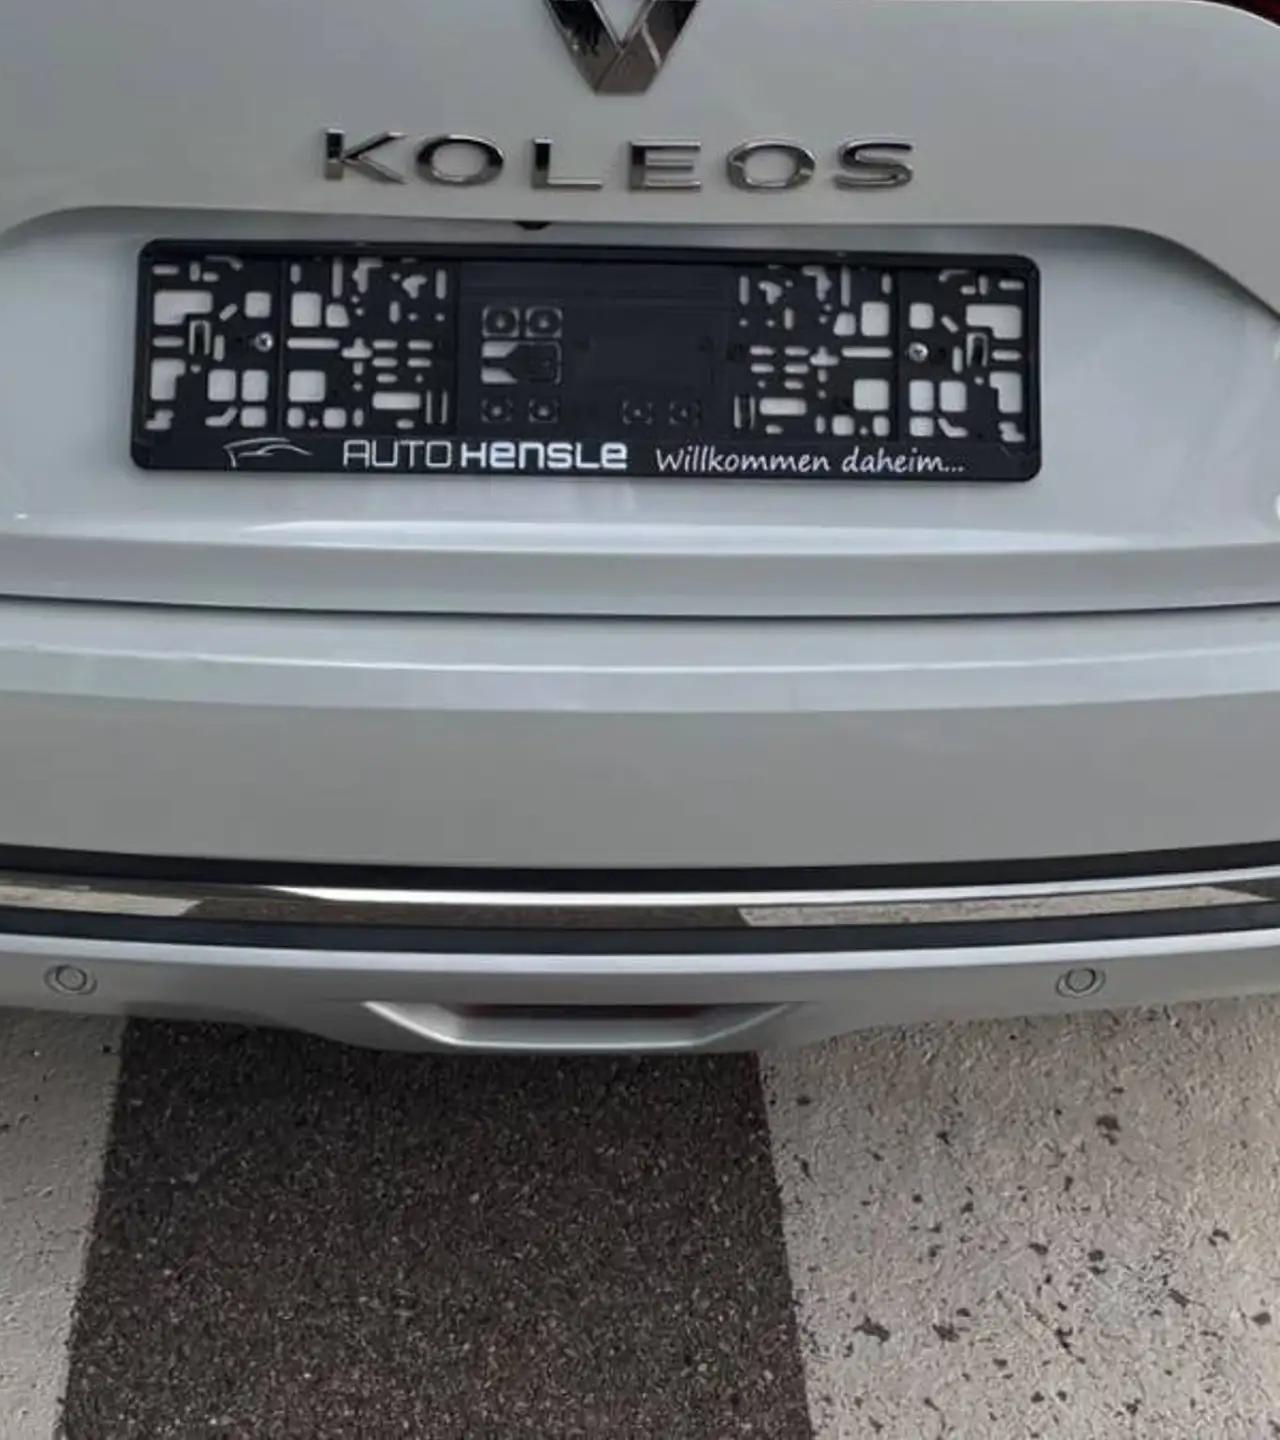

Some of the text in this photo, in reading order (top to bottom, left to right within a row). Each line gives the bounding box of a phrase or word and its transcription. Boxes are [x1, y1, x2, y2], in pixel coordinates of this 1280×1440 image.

[323, 128, 915, 192] KOLEOS
[343, 439, 452, 469] AUTO
[656, 445, 832, 474] Willkommen
